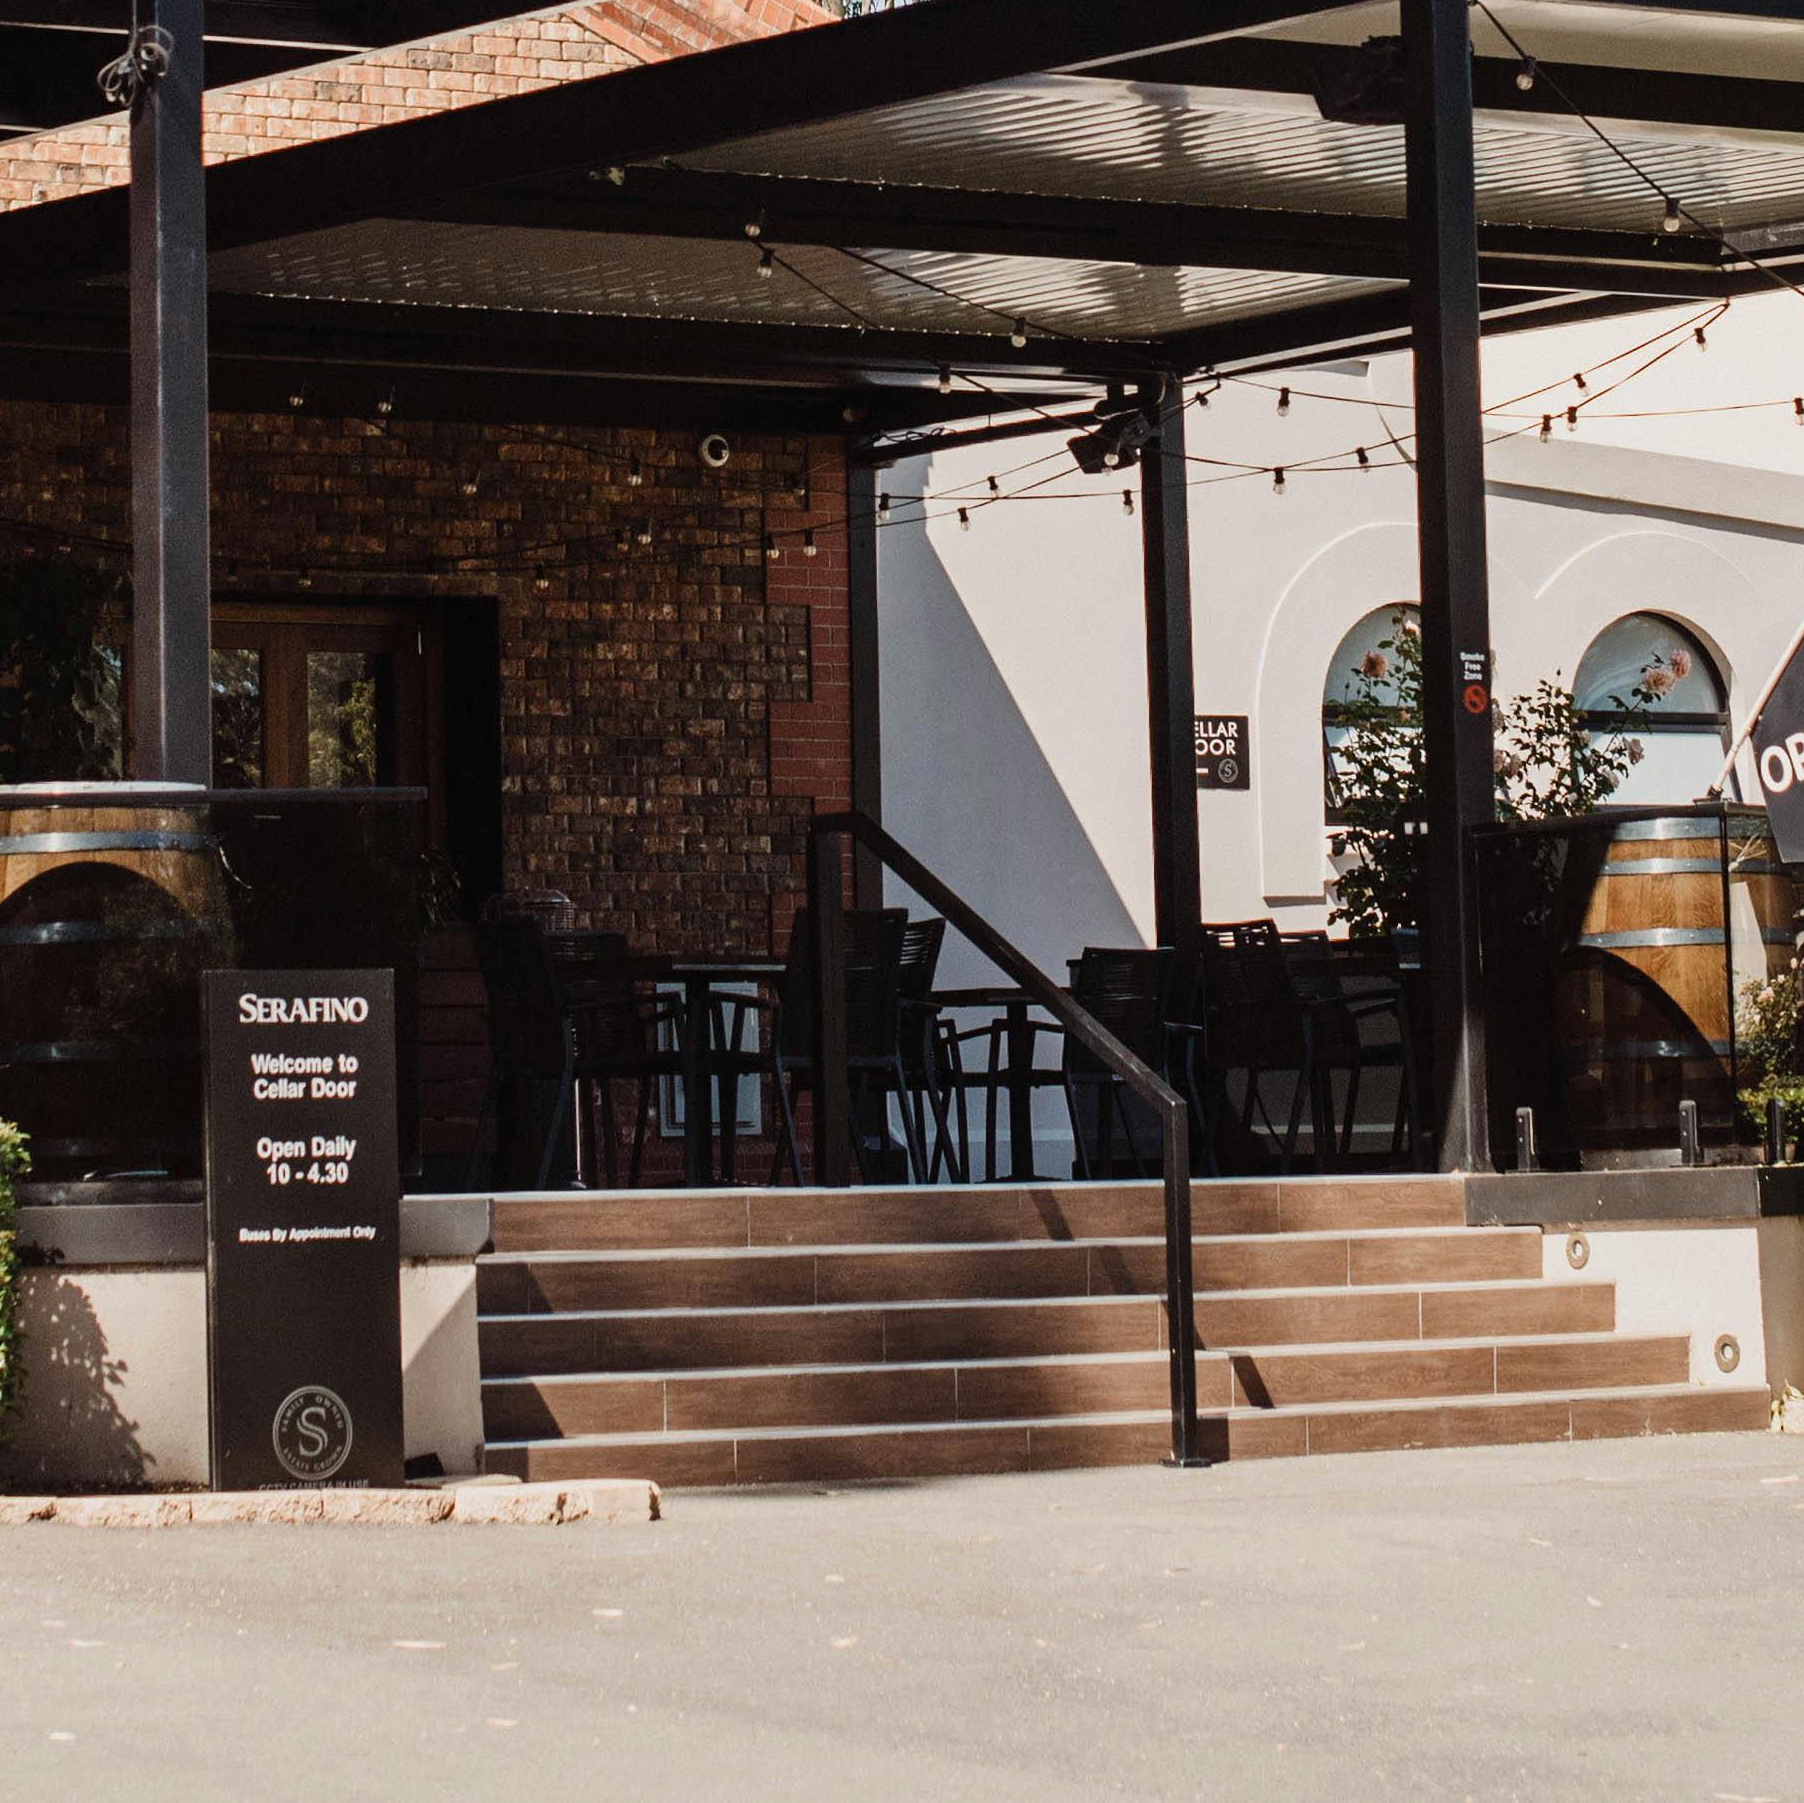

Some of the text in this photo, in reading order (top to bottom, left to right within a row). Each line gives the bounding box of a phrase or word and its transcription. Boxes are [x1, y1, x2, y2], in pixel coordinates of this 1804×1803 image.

[1464, 662, 1481, 671] Free
[1194, 721, 1238, 737] ELLAR
[1195, 739, 1236, 755] OOR
[239, 993, 369, 1024] SERAFINO
[251, 1053, 358, 1075] Welcome to
[254, 1078, 357, 1100] Cellar Door
[257, 1136, 356, 1163] Open Daily
[267, 1163, 291, 1184] 10
[307, 1162, 349, 1184] 4.30
[239, 1226, 376, 1243] Buses By Appointment Only
[297, 1407, 328, 1456] S
